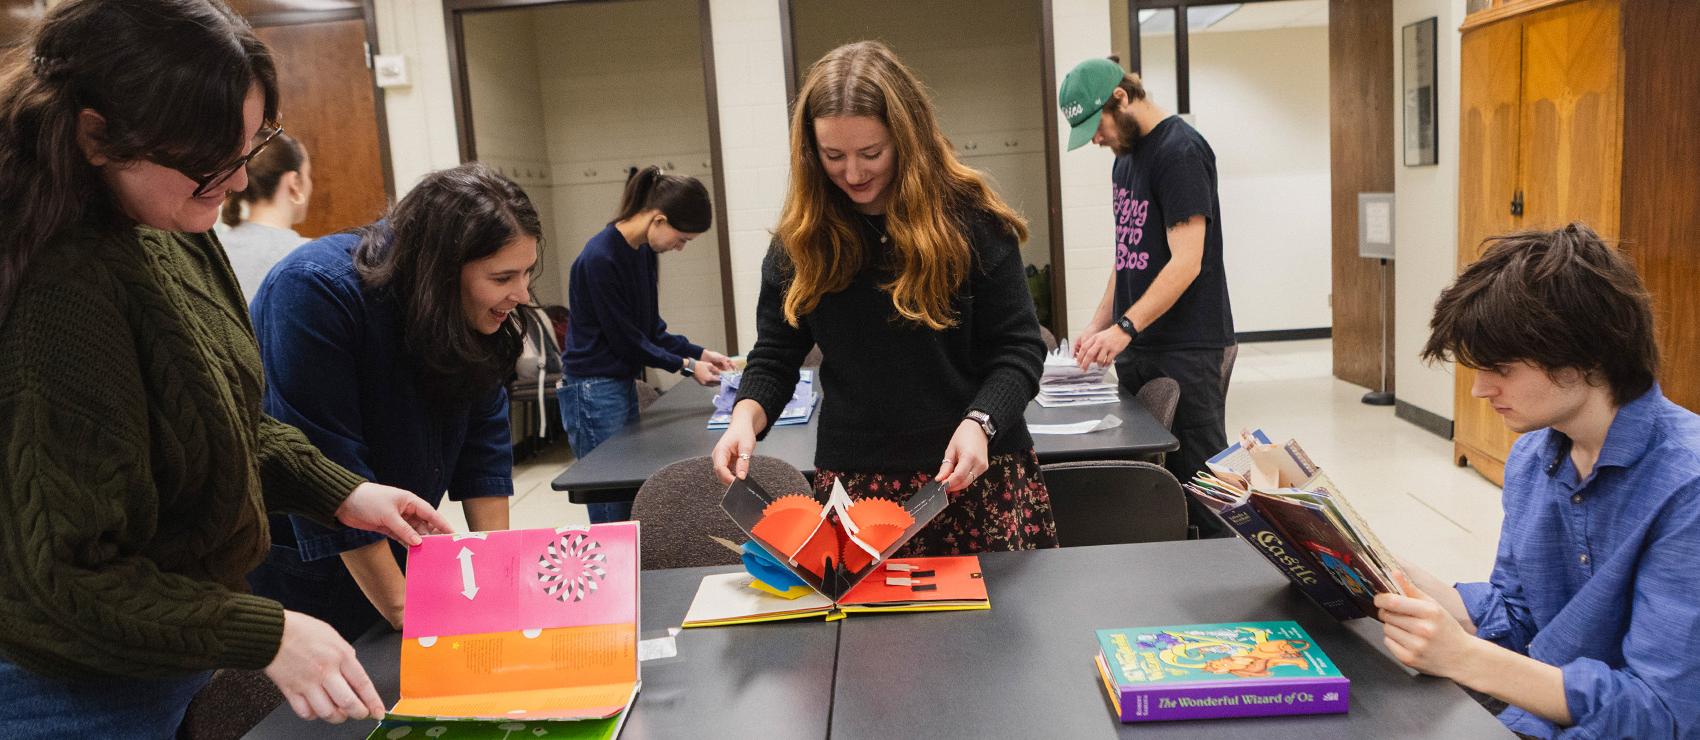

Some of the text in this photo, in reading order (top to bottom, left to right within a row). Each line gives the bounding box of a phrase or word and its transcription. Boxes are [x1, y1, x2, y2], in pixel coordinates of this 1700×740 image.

[1252, 531, 1317, 584] Castle
[1159, 697, 1177, 709] The
[1178, 695, 1239, 708] Wonderful
[1241, 693, 1283, 705] Wizard
[1284, 691, 1297, 705] of
[1297, 691, 1314, 703] Oz
